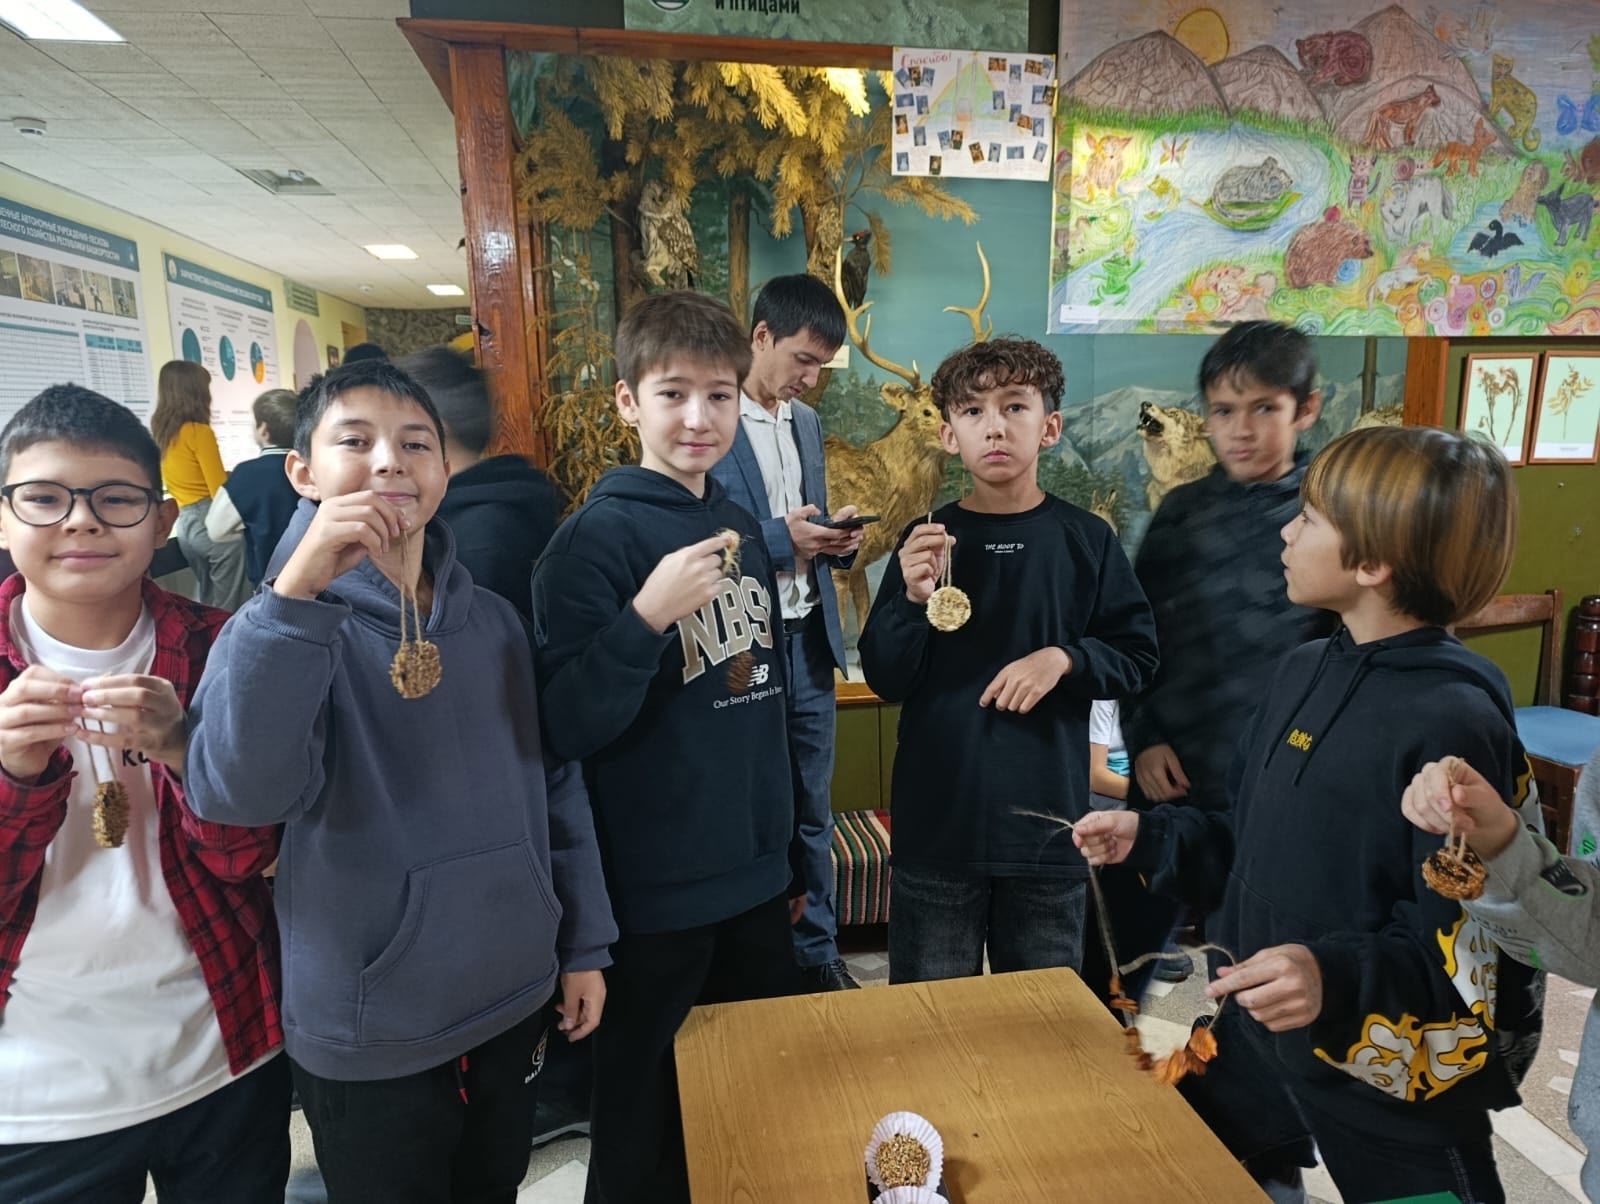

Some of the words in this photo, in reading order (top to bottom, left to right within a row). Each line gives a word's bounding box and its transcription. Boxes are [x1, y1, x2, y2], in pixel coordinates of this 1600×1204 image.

[730, 0, 800, 16] птицами
[713, 699, 729, 709] Our
[729, 694, 750, 704] Story
